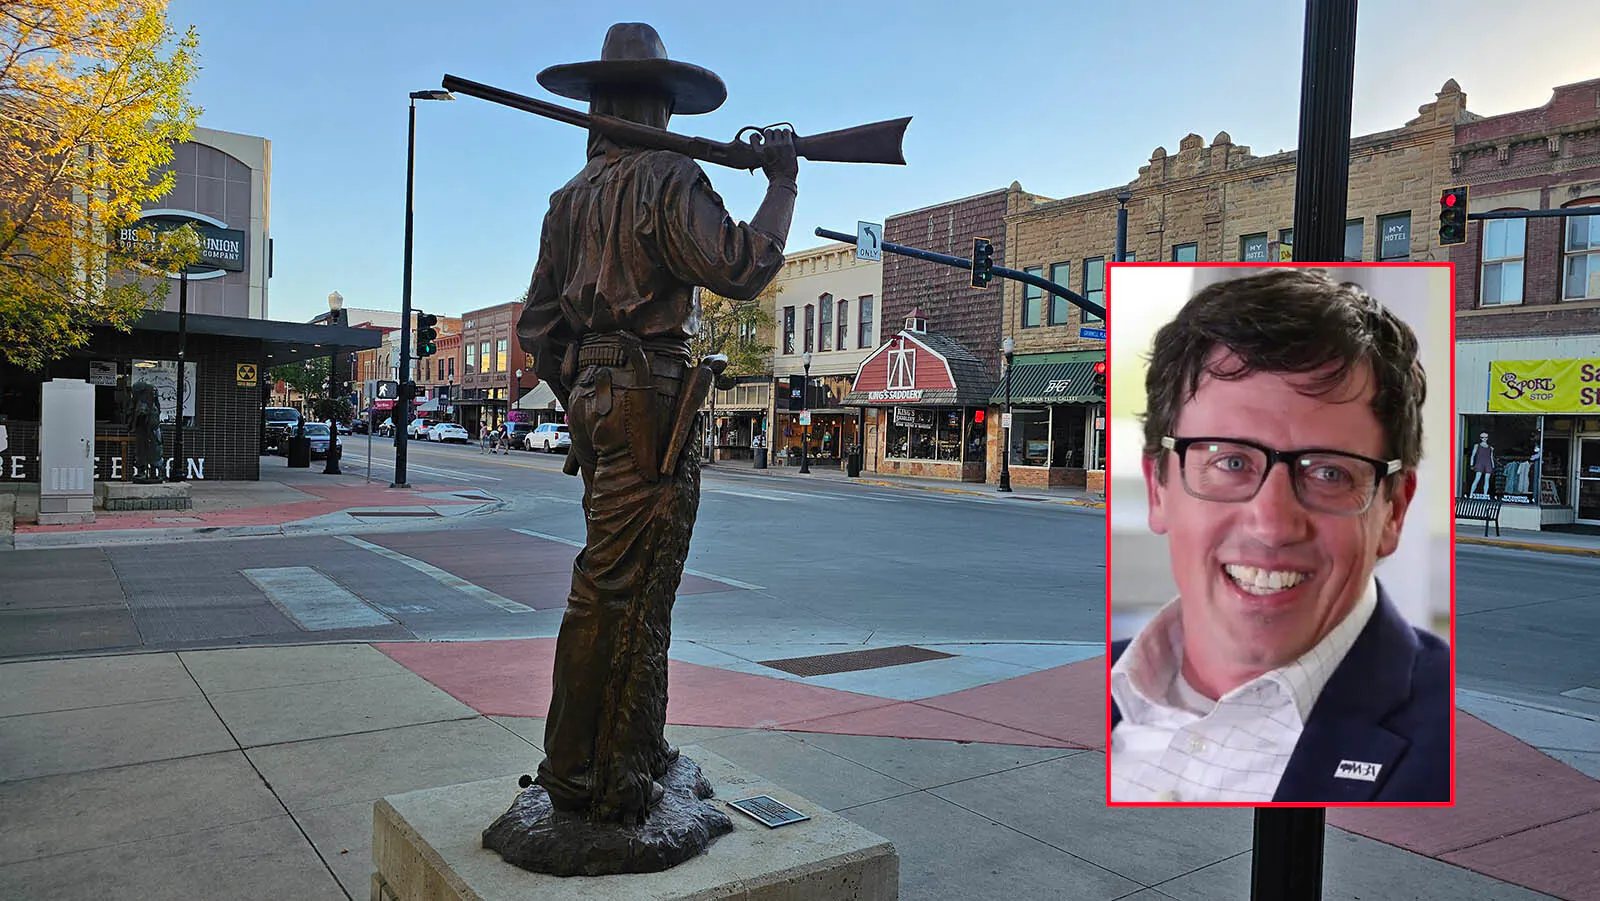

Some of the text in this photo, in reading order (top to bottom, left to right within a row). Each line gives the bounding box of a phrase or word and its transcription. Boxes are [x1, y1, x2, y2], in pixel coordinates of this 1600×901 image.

[1389, 225, 1404, 233] MY
[203, 238, 240, 253] UNION
[202, 251, 240, 261] COMPANY
[860, 248, 879, 258] ONLY
[868, 389, 924, 400] KING'S SADDLERY
